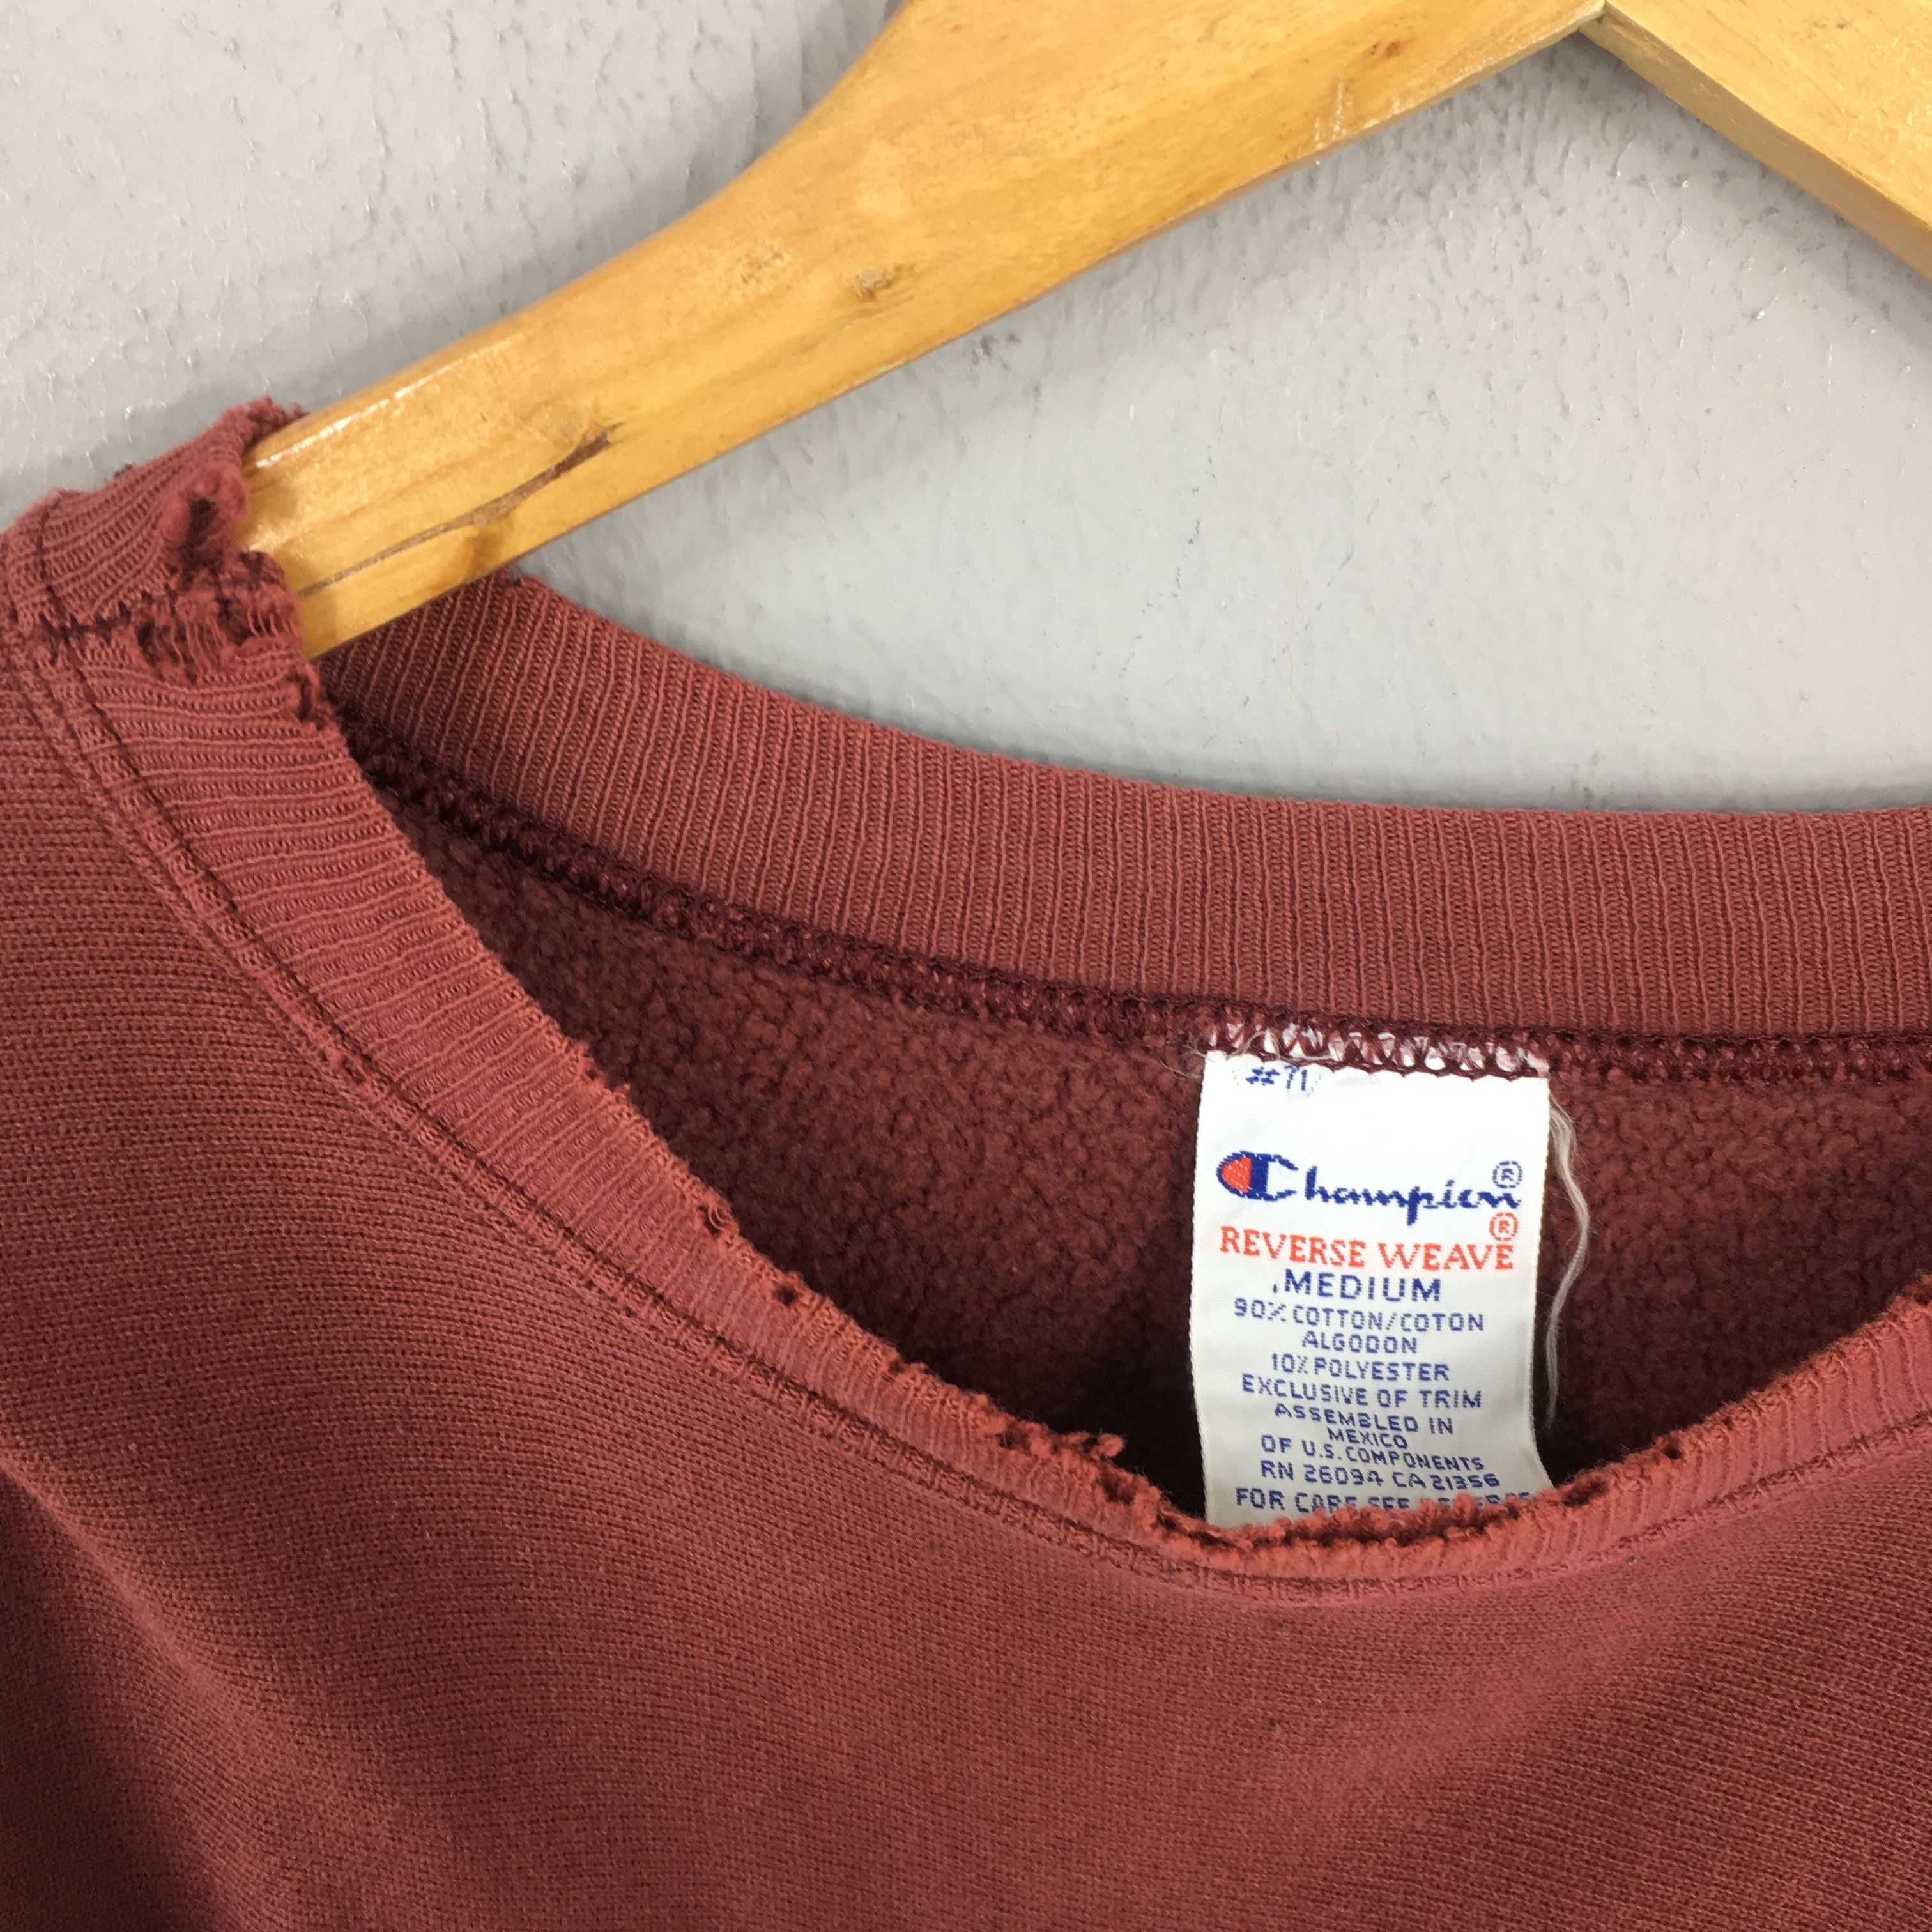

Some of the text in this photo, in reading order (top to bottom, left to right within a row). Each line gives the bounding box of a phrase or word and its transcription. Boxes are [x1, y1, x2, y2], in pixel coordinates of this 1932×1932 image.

[1216, 1150, 1521, 1226] Champion
[1219, 1225, 1366, 1268] REVERSE
[1379, 1243, 1514, 1270] WEAVE
[1284, 1269, 1441, 1302] MEDIUM
[1301, 1330, 1418, 1354] ALGODON
[1314, 1356, 1450, 1381] POLYESTER
[1242, 1373, 1482, 1409] EXCLUSIVE OF TRIM
[1274, 1402, 1453, 1435] ASSEMBLED IN
[1261, 1434, 1292, 1455] OF
[1346, 1446, 1485, 1471] COMPONENTS
[1326, 1427, 1408, 1449] MEXICO
[1261, 1459, 1294, 1481] RN
[1302, 1464, 1384, 1487] 26094
[1235, 1487, 1285, 1511] FOR
